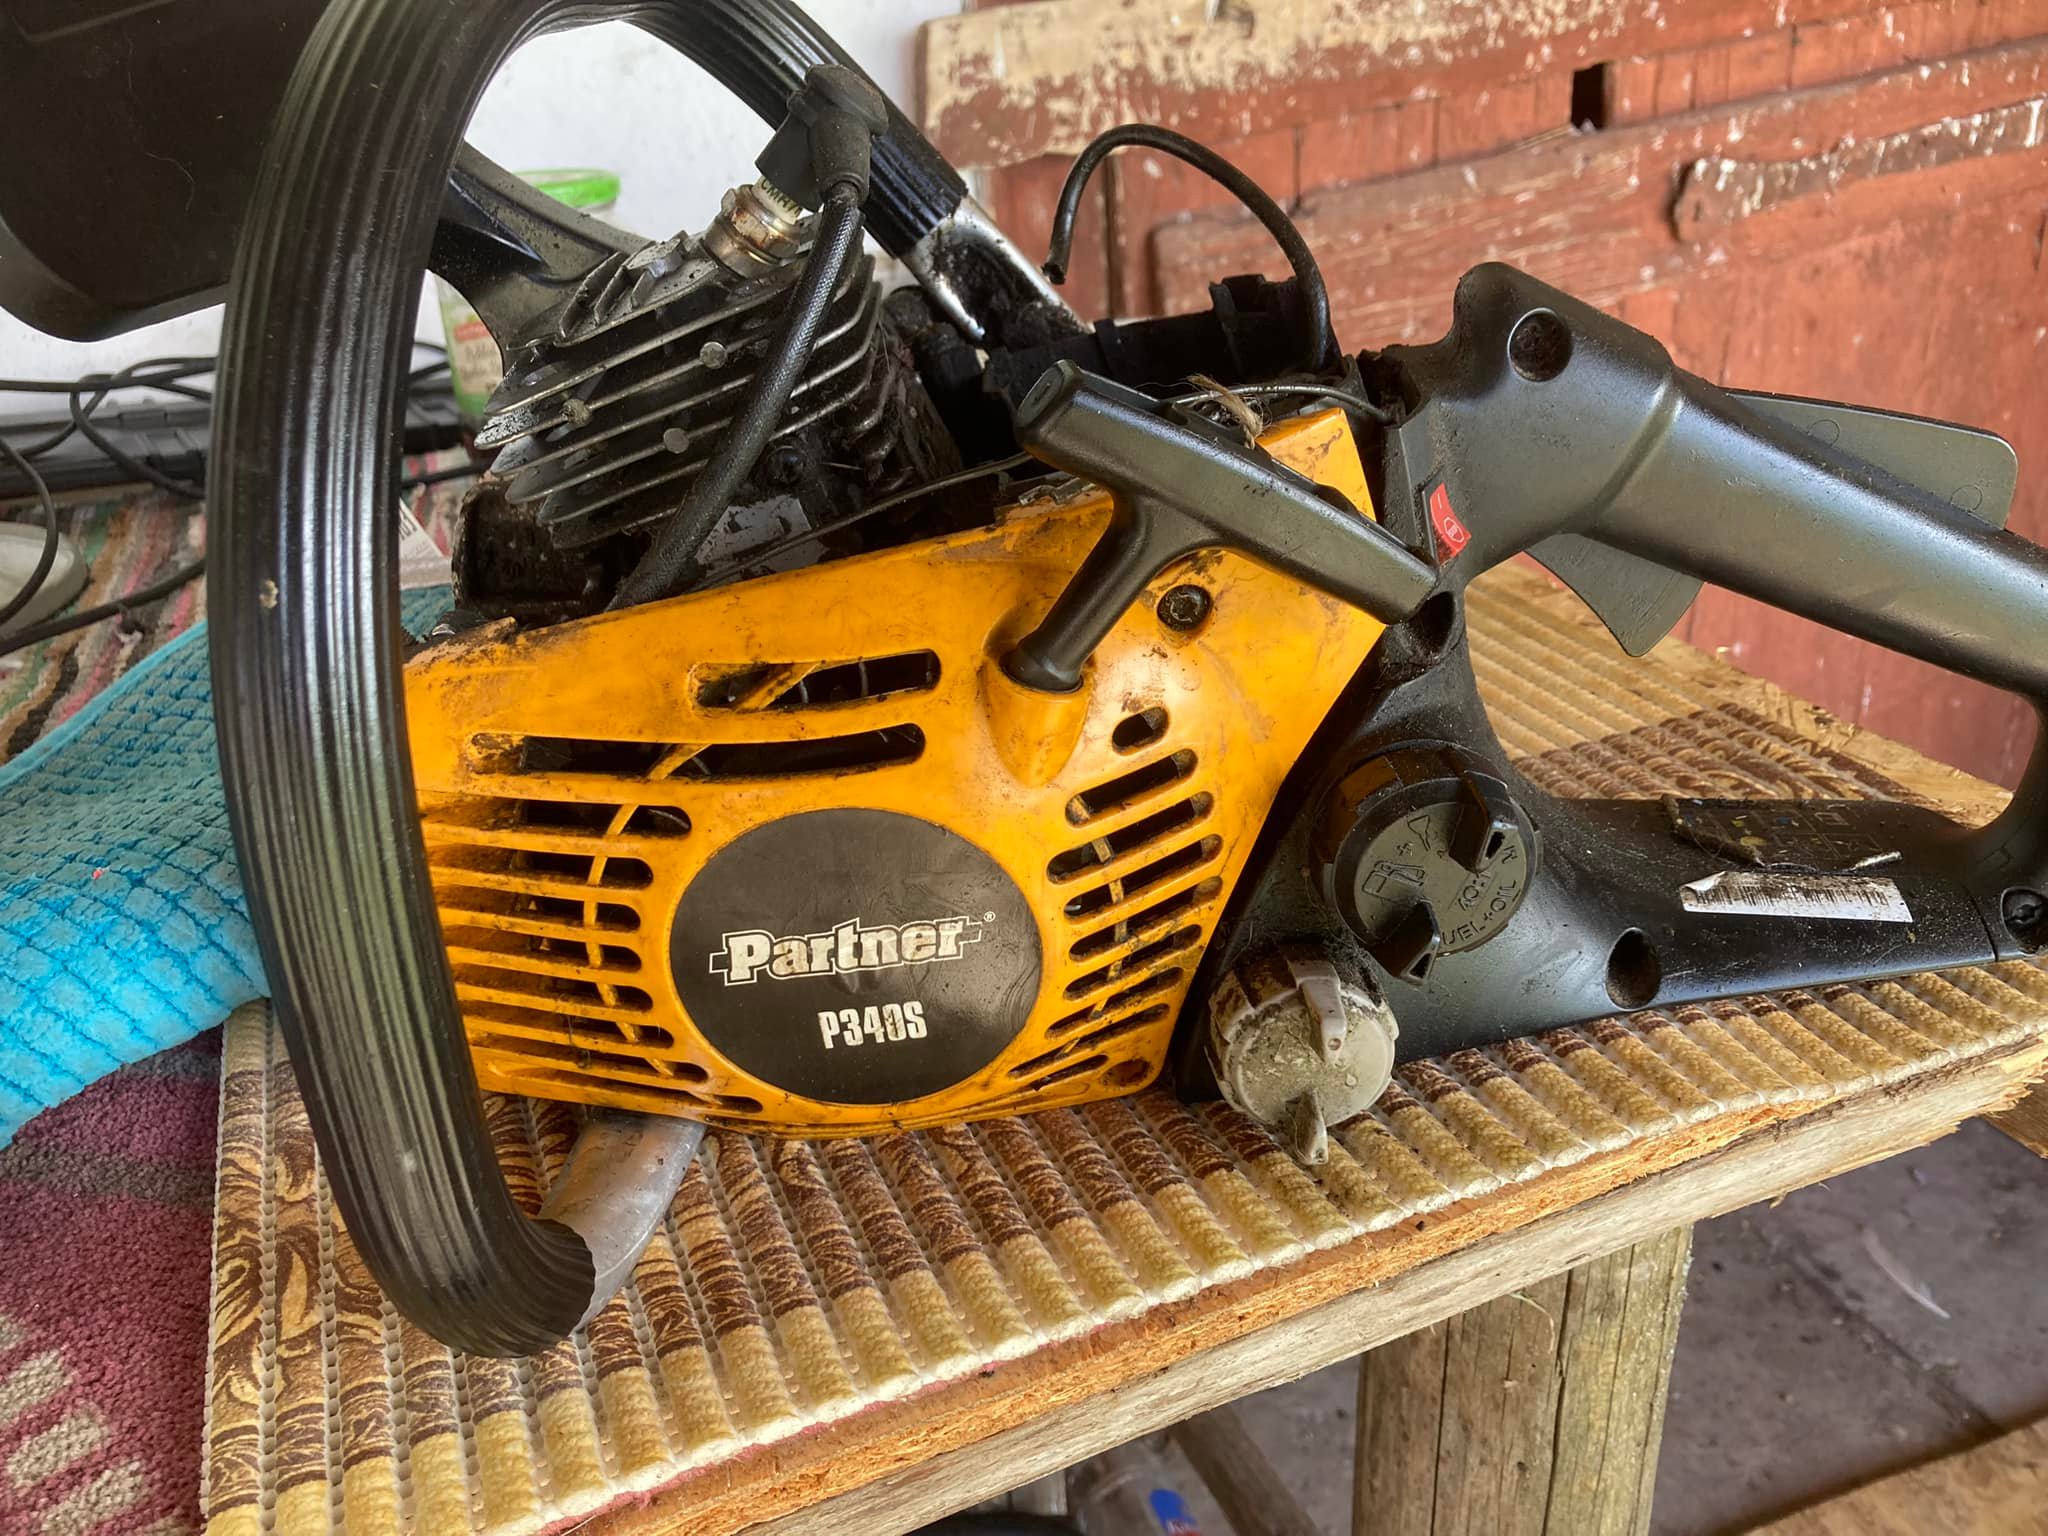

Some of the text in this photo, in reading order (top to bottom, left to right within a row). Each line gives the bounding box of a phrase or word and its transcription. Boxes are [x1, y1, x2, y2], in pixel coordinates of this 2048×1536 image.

[1440, 879, 1522, 946] UEL+OIL
[722, 917, 969, 986] Partner
[817, 1000, 929, 1050] P340S
